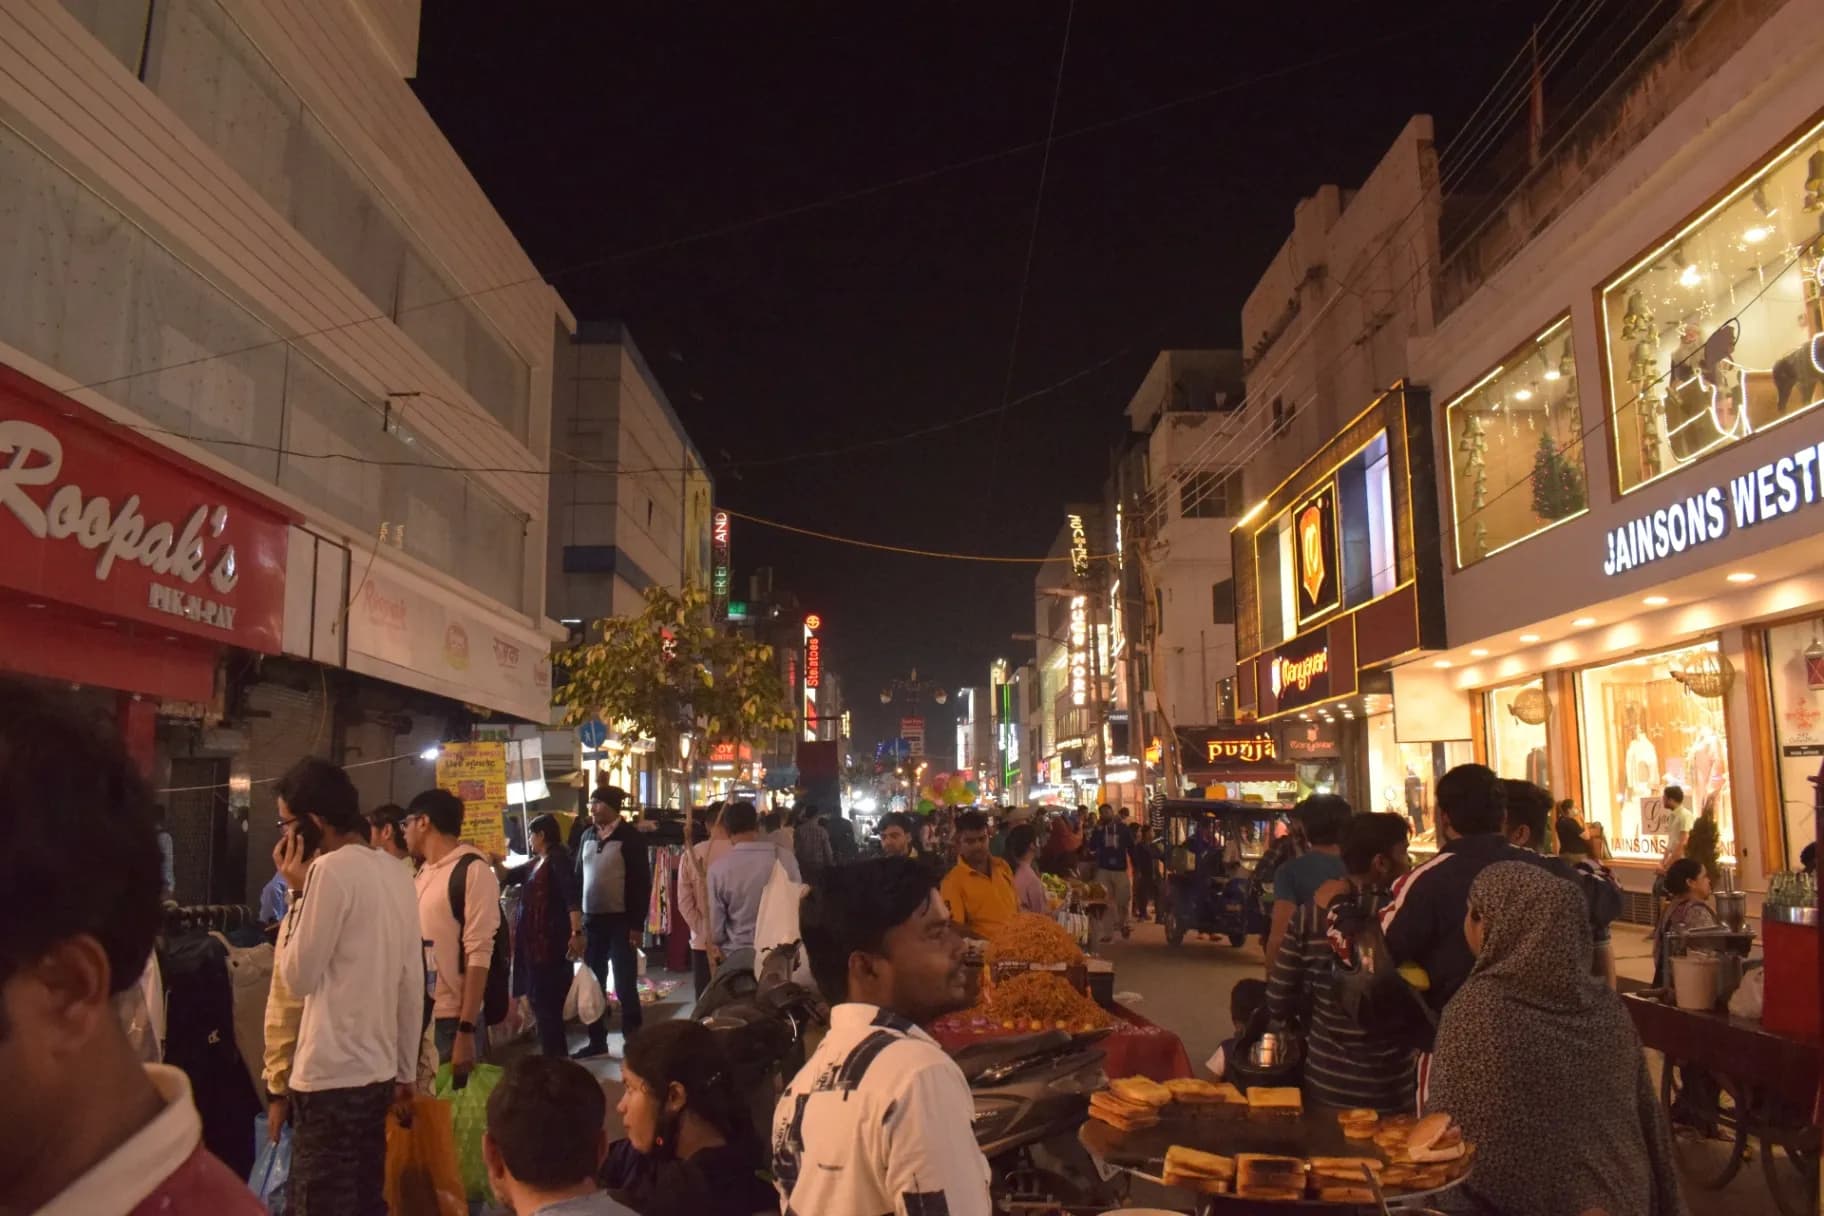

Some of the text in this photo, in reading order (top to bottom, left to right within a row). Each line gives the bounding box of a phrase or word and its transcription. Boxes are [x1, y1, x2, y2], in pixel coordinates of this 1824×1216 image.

[0, 420, 239, 594] Roopak's
[1604, 441, 1824, 576] JAINSONS WEST
